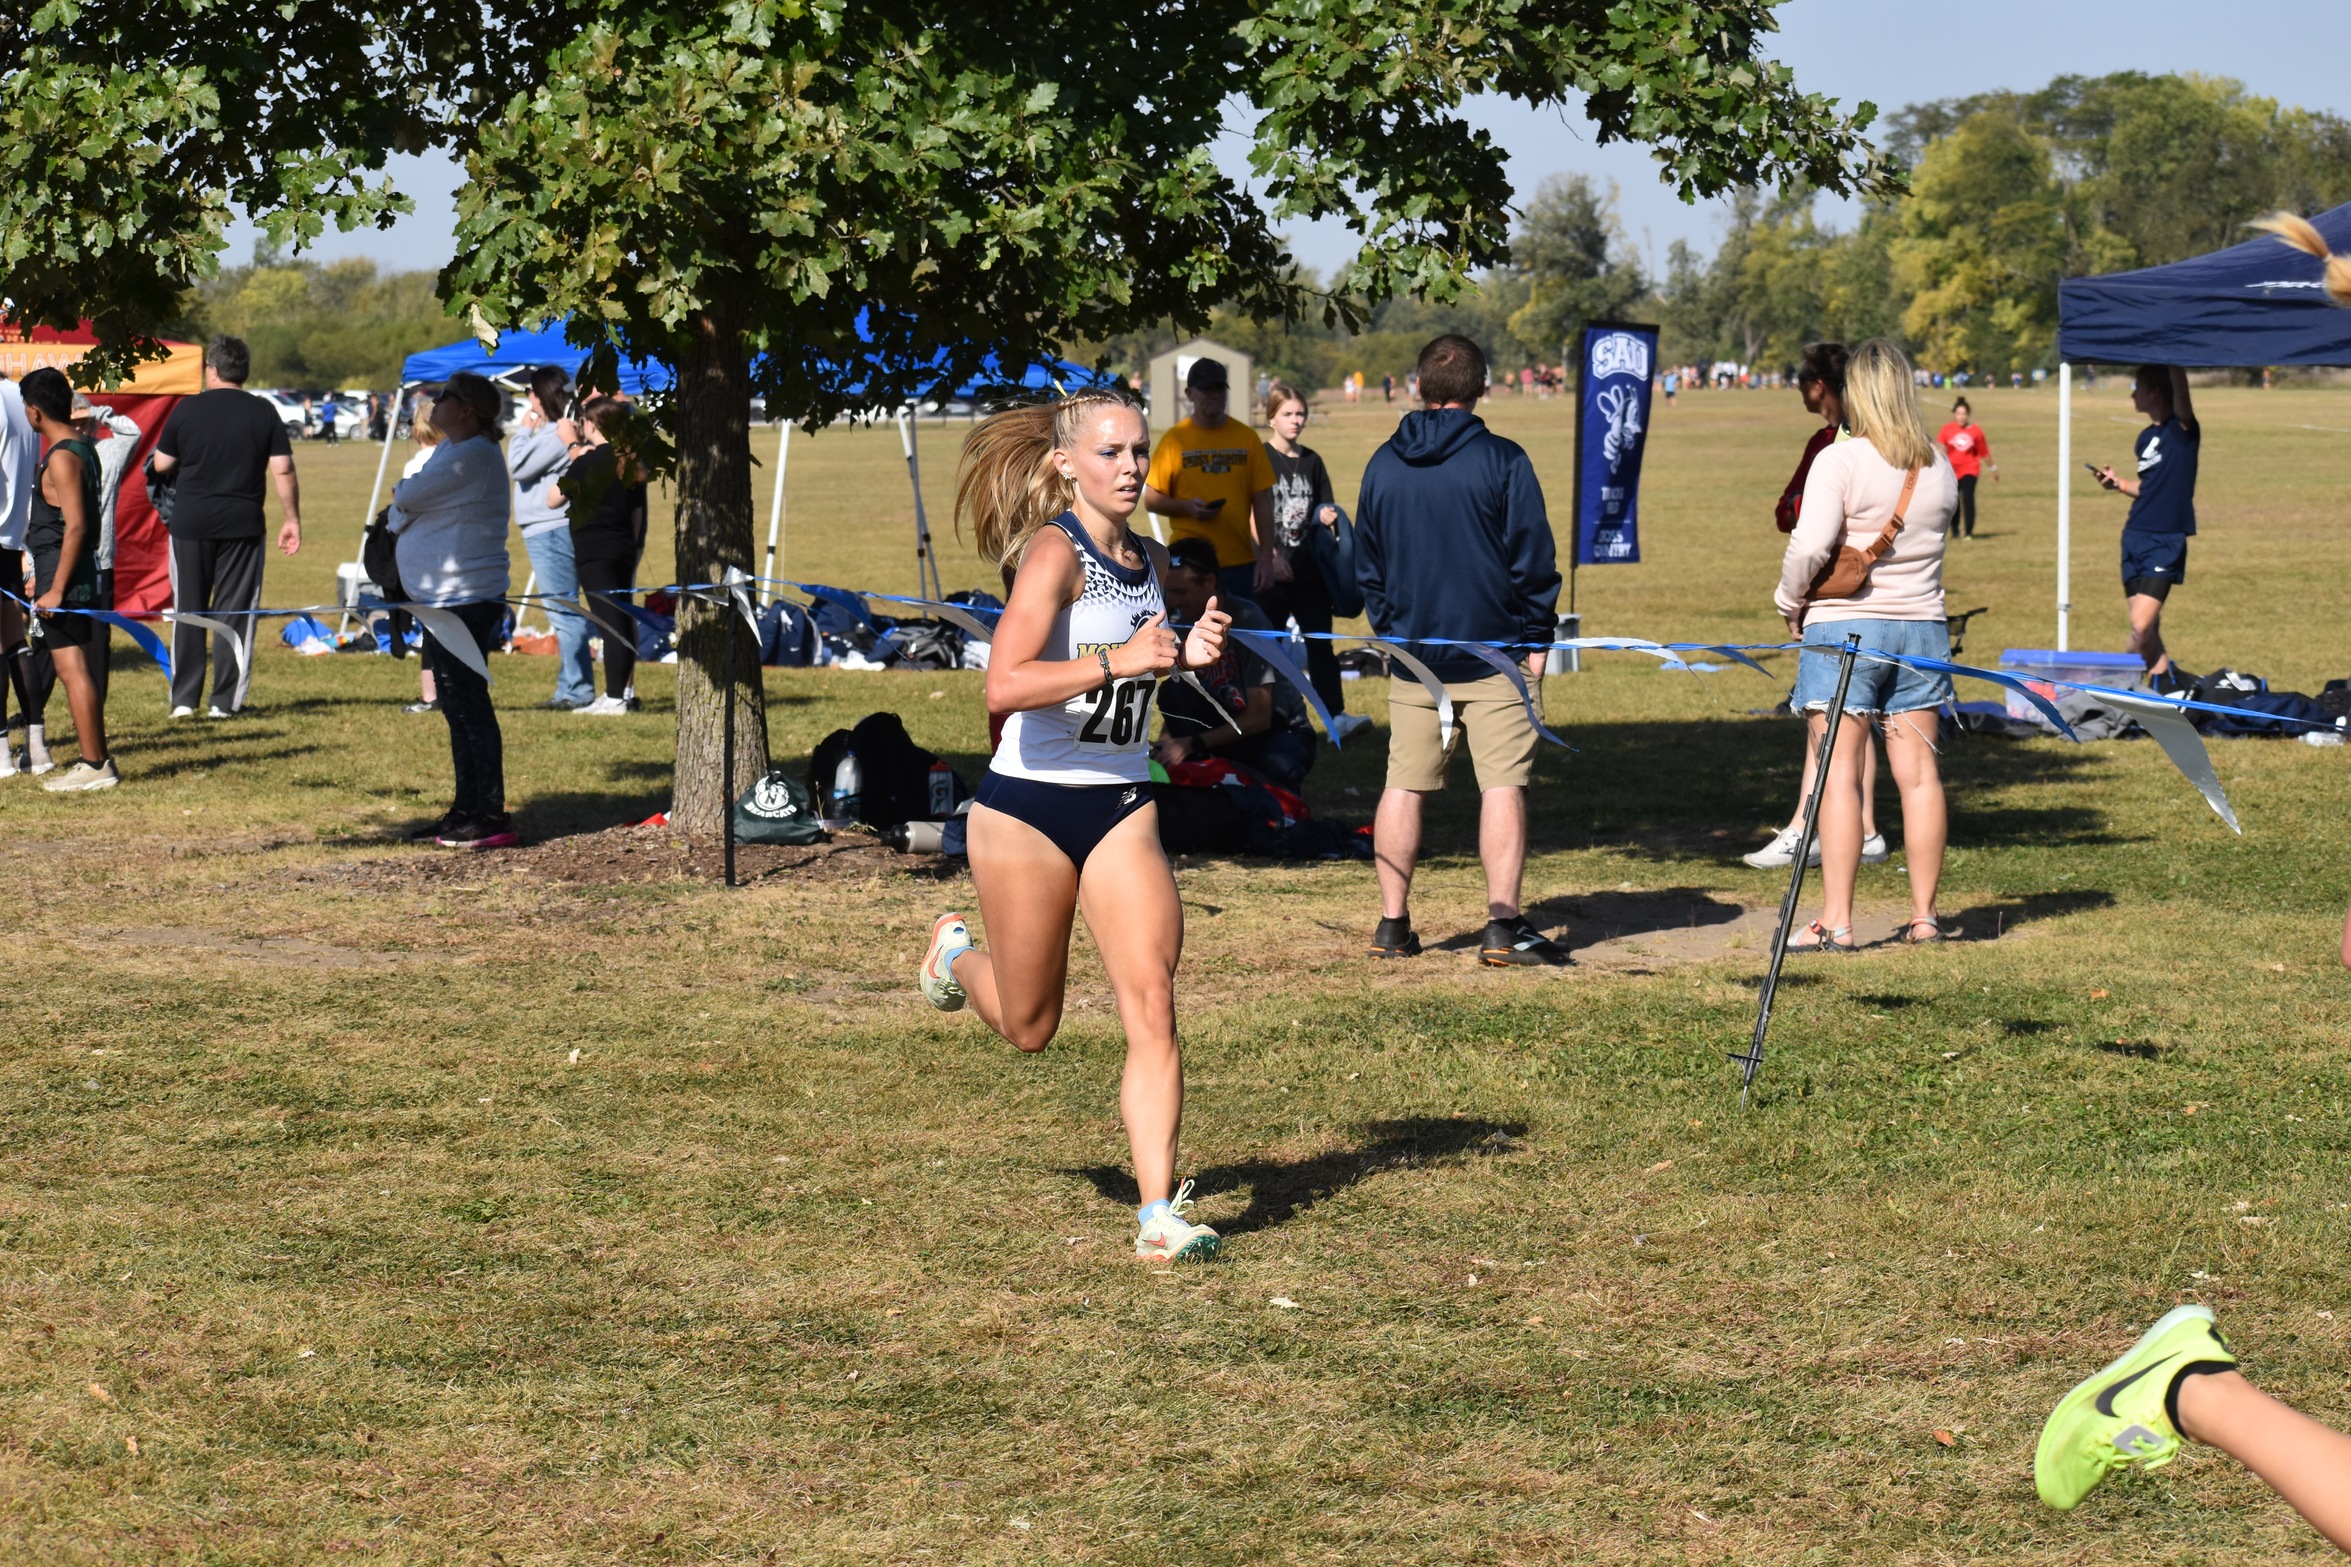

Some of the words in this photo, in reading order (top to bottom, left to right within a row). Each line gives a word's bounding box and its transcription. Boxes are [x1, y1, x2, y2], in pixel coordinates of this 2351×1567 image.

[1592, 332, 1648, 381] SAU
[1079, 680, 1157, 746] 267
[744, 801, 797, 818] BEARCATS
